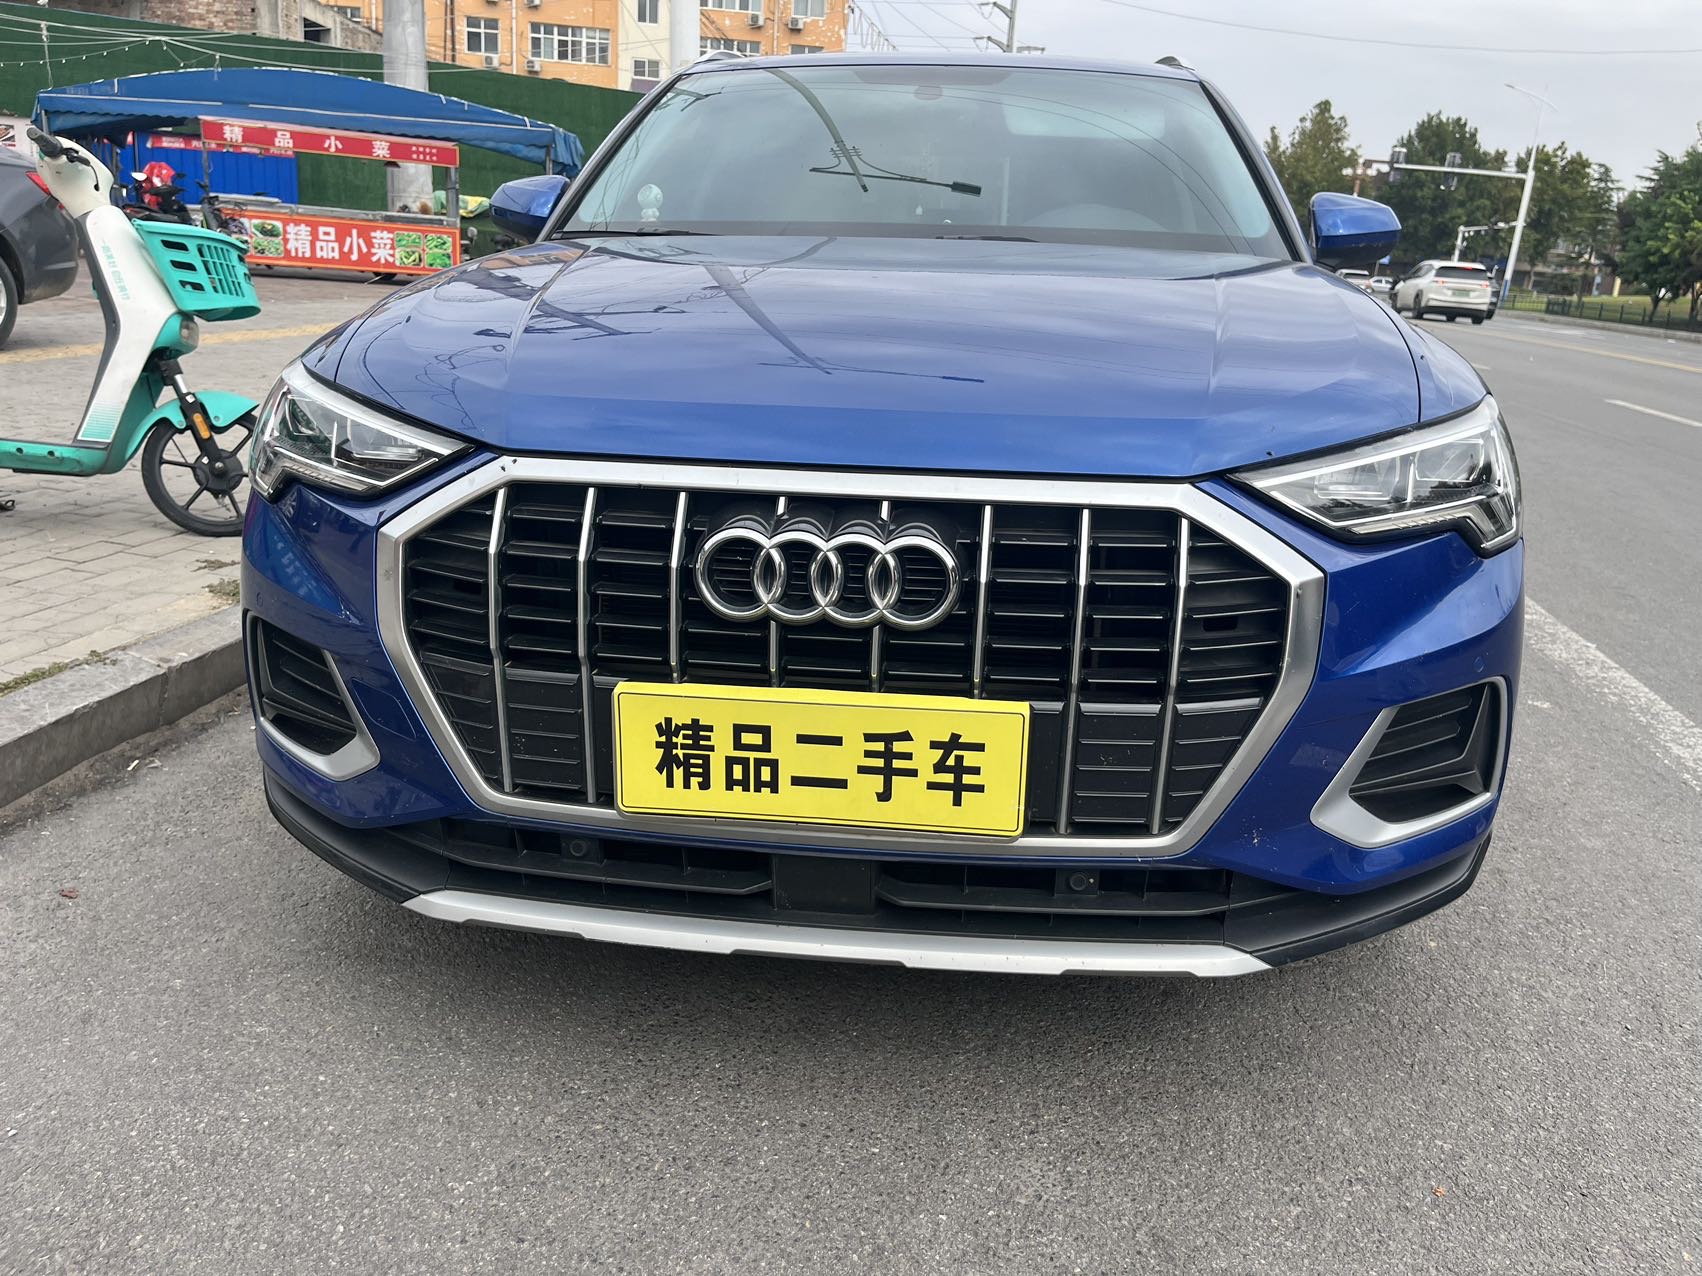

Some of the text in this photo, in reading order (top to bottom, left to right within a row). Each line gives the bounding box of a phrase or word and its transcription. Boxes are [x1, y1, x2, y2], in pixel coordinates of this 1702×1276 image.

[223, 125, 391, 158] 精品小菜
[286, 223, 395, 263] 精品小菜
[655, 716, 986, 807] 精品二手车
